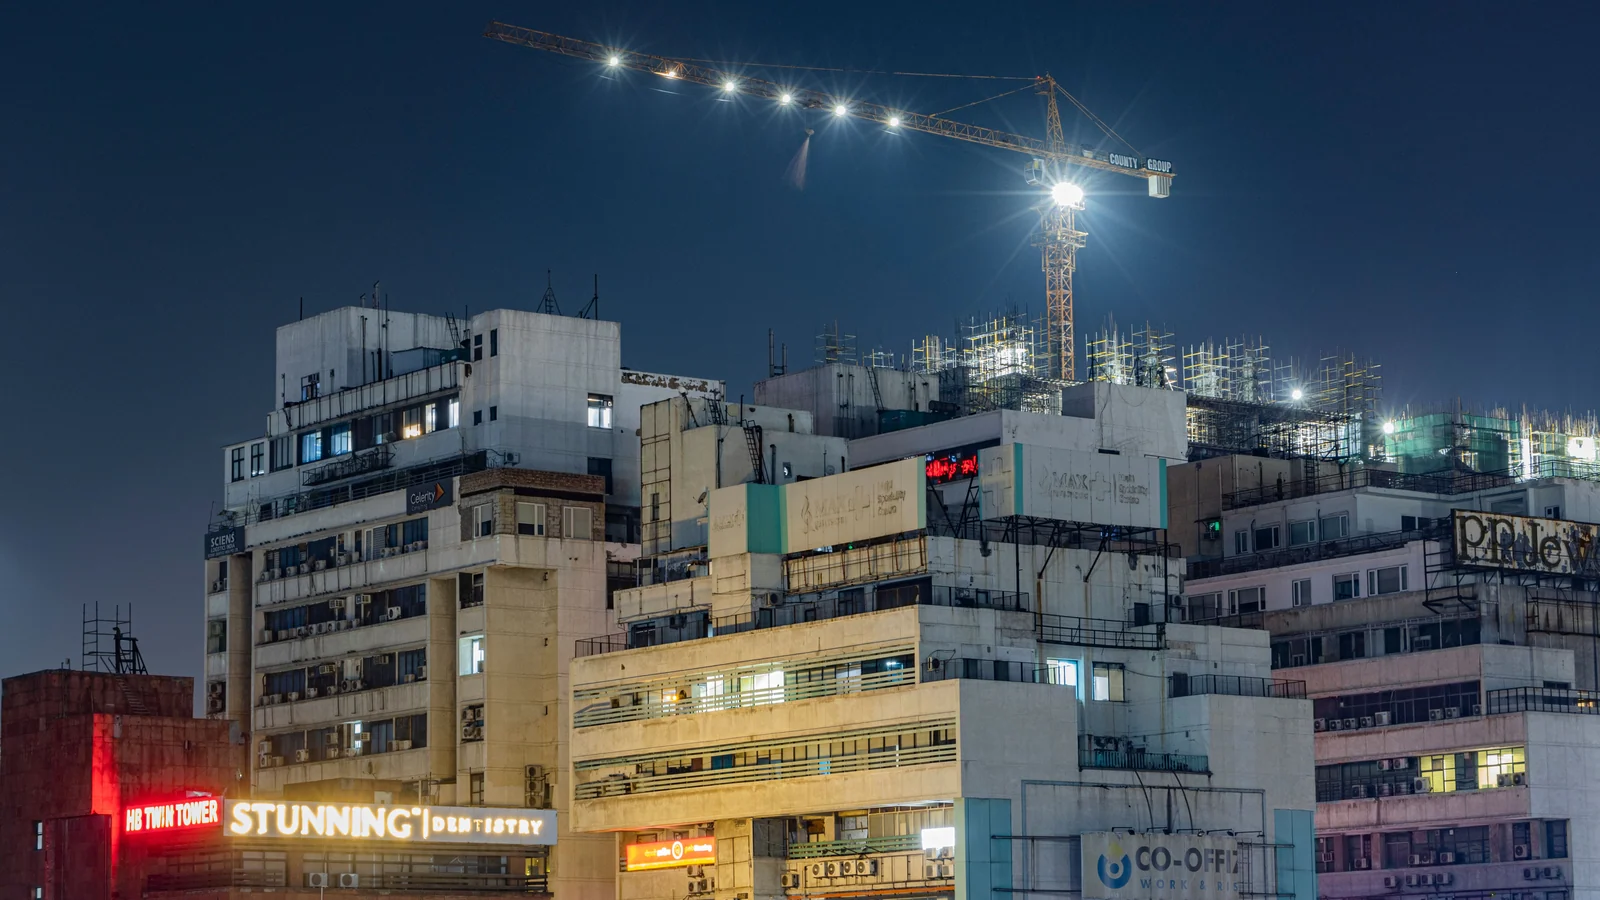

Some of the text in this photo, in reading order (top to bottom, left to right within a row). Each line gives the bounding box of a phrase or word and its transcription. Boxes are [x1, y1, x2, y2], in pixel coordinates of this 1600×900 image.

[1109, 153, 1172, 173] COUNTY GROUP
[410, 491, 436, 504] Celerity
[210, 533, 235, 548] SCIENS
[126, 799, 218, 832] HB TWIN TOWER
[230, 802, 543, 839] STUNNING DENTISTRY
[1141, 879, 1187, 889] WORK
[1200, 880, 1207, 890] &
